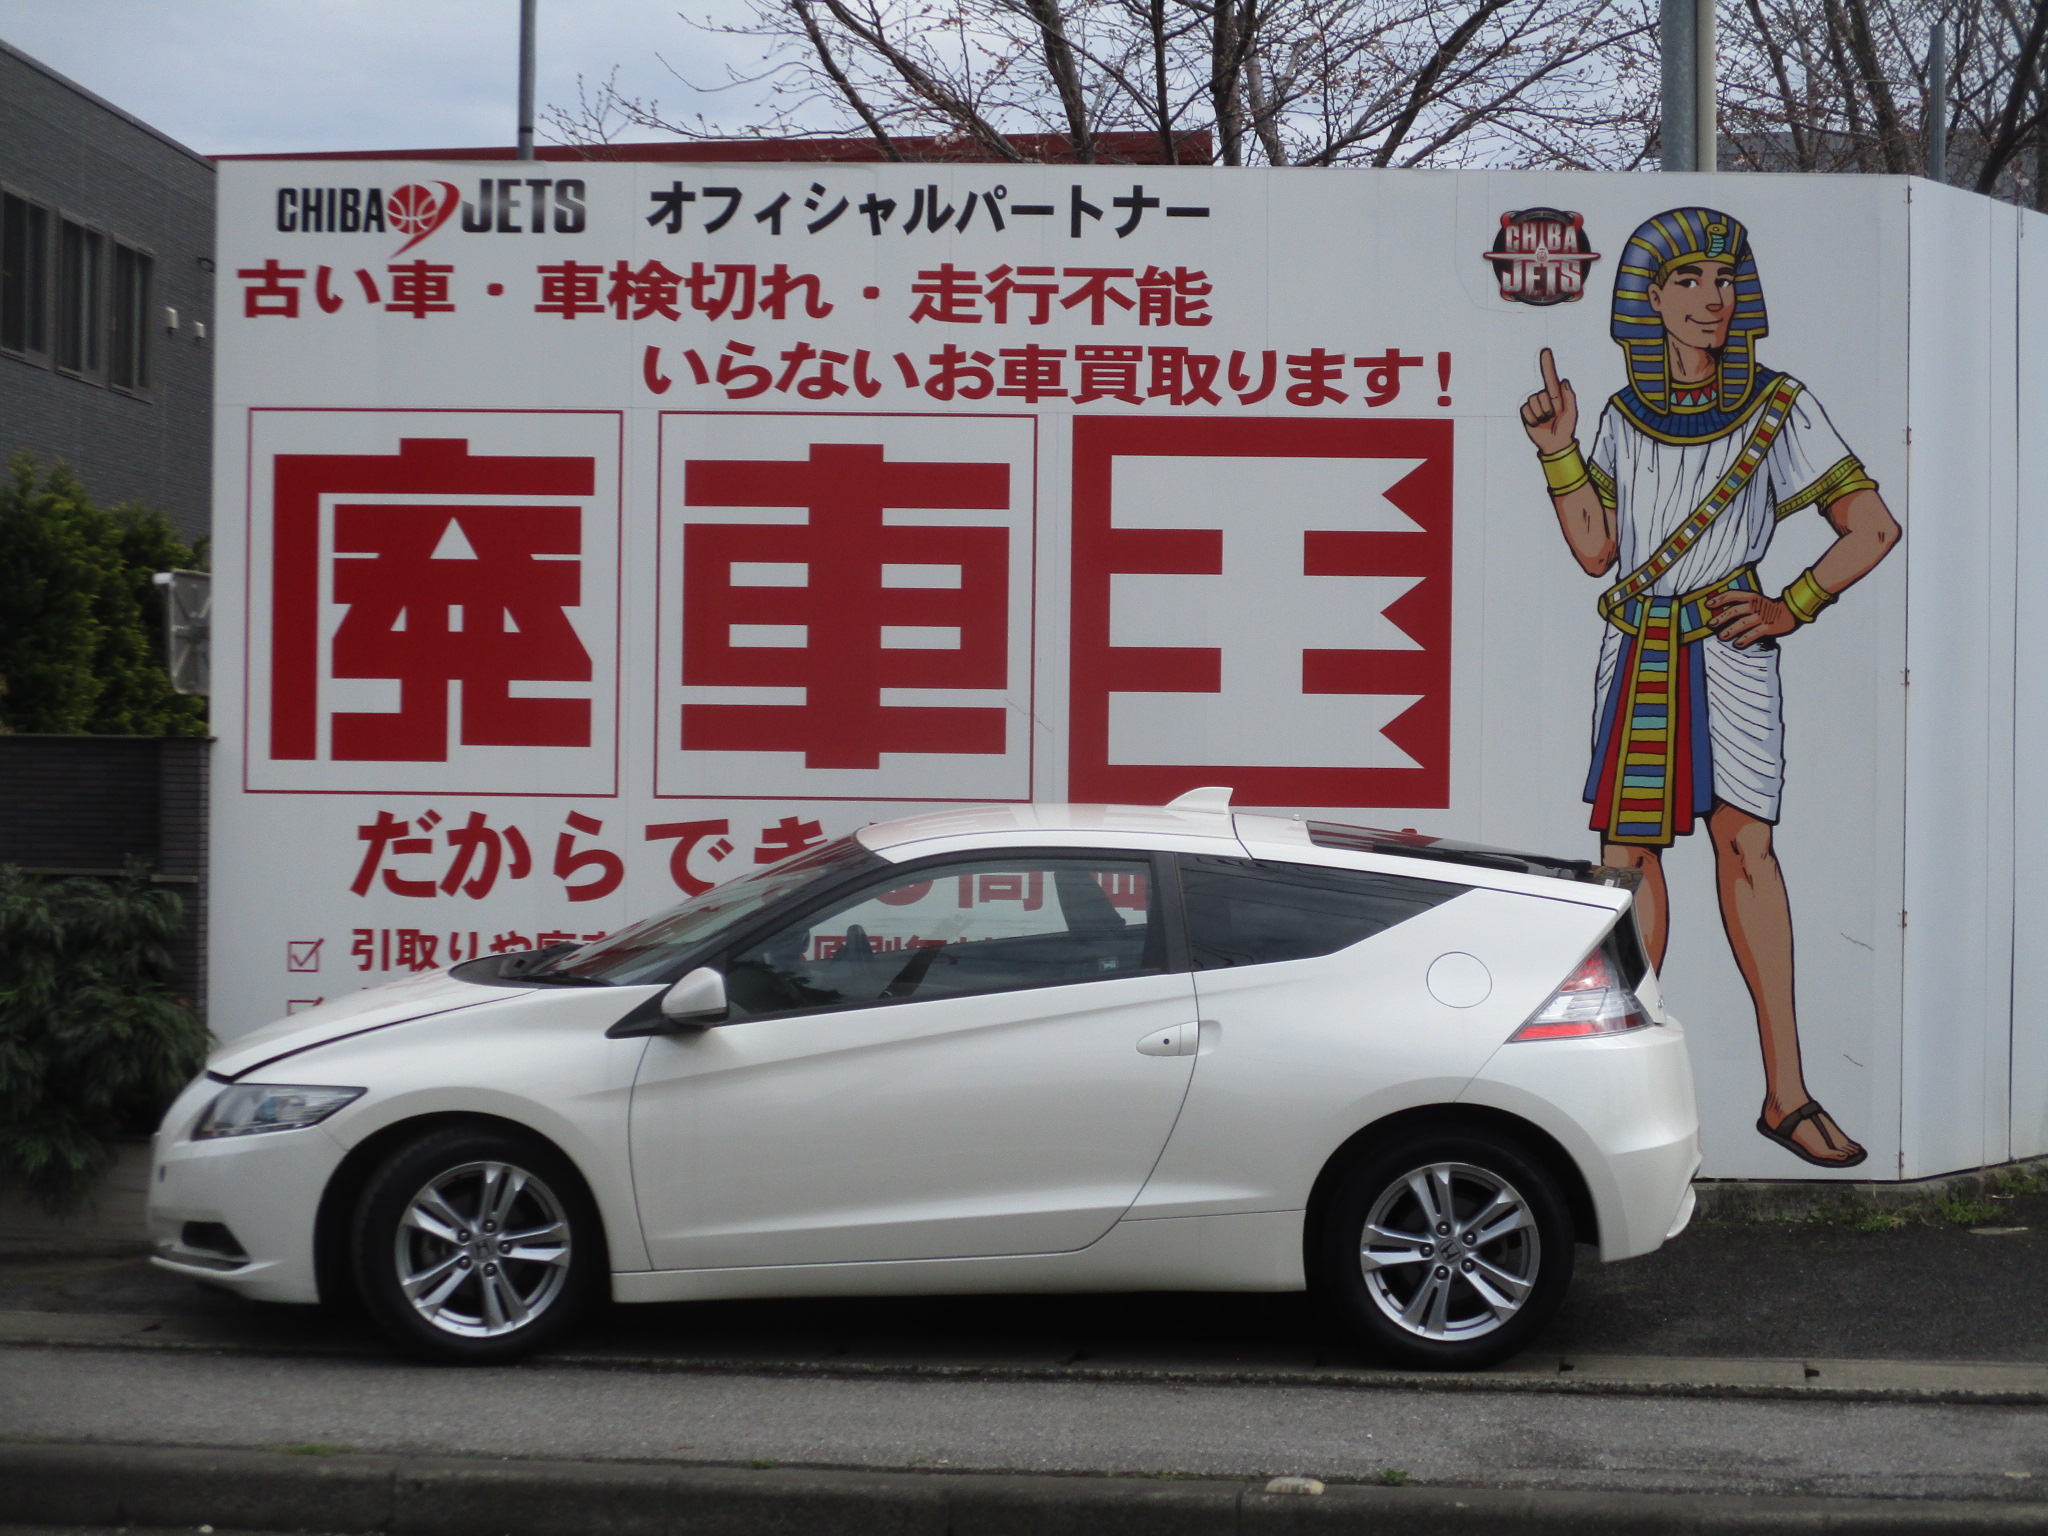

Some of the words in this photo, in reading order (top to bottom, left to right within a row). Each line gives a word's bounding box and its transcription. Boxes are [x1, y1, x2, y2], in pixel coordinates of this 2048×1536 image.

[276, 187, 385, 234] CHIBA
[461, 178, 587, 235] JETS
[646, 180, 1211, 240] オフィシャルパートナー
[1505, 221, 1580, 253] CHIBA
[237, 258, 1213, 327] 古い車・車検切れ・走行不能
[1501, 259, 1583, 297] JETS
[644, 341, 1454, 409] いらないお車買取ります!
